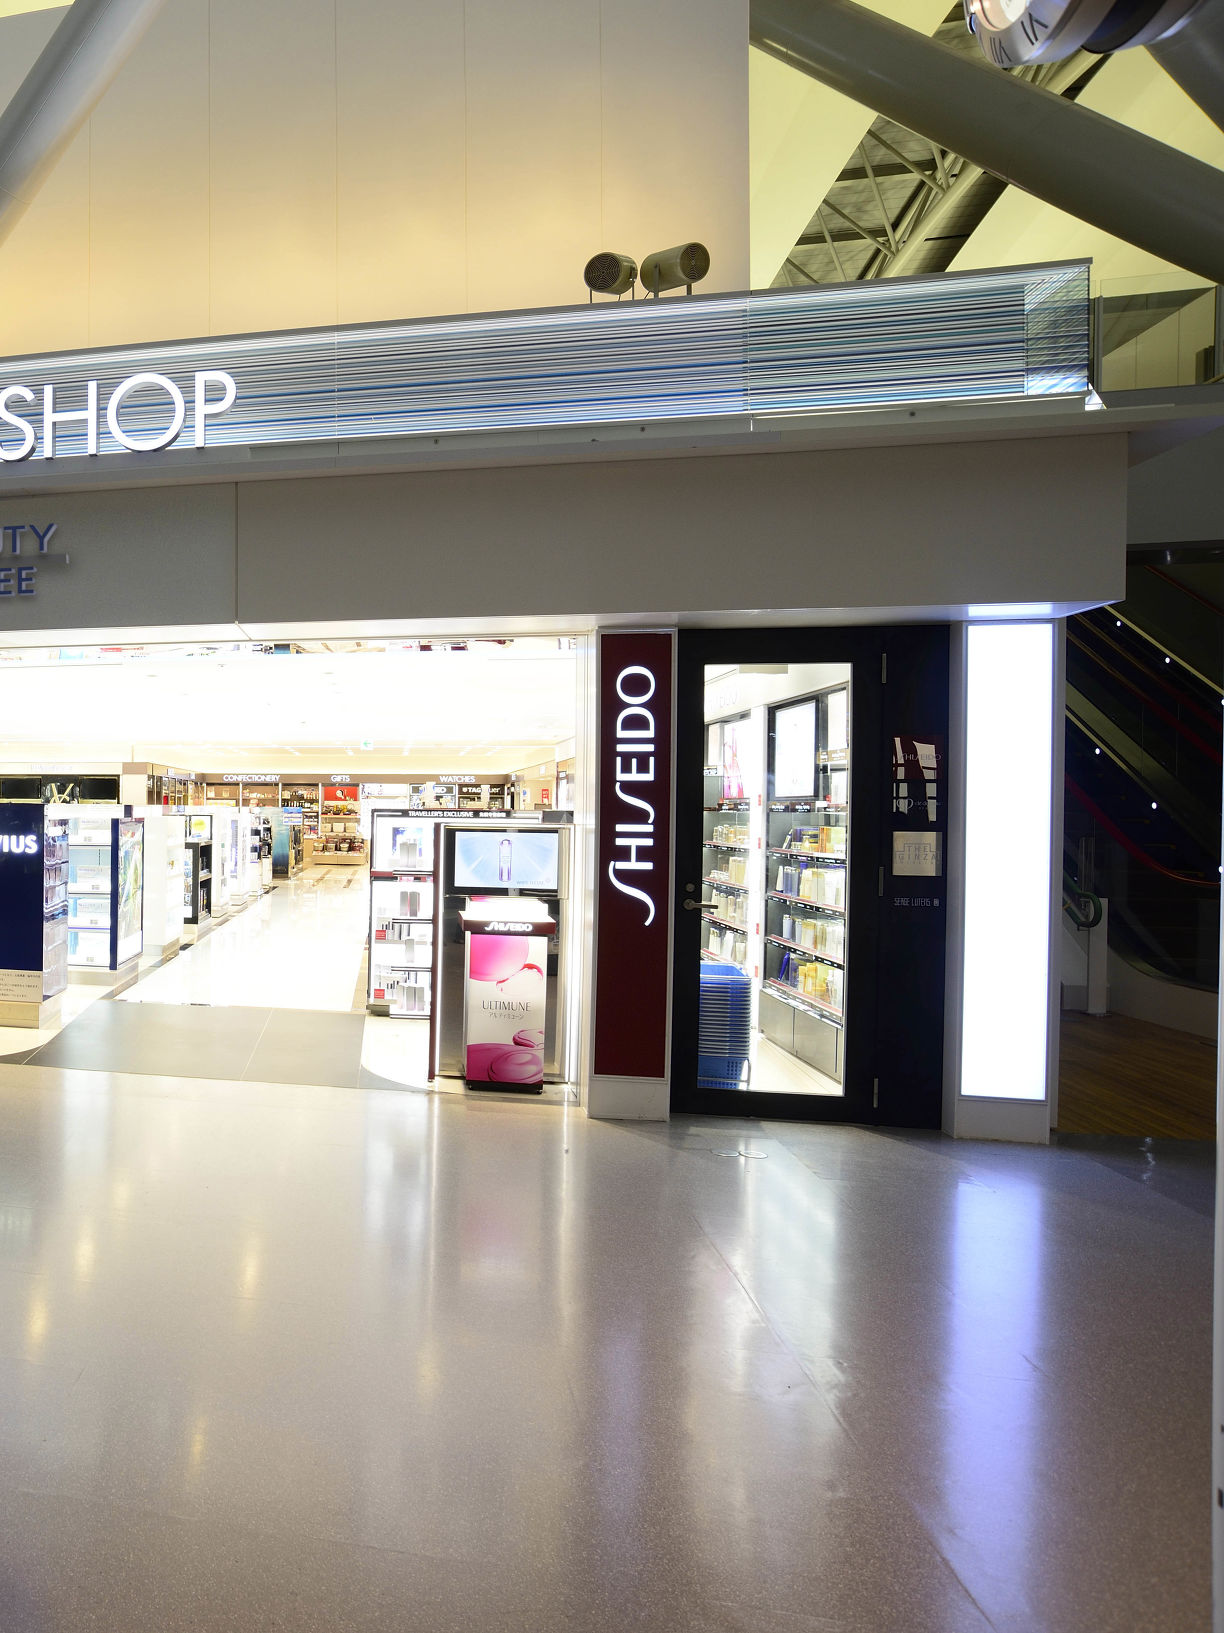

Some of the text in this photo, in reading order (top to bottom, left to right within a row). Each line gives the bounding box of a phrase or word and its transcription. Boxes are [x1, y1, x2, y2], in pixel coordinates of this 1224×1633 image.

[223, 774, 280, 782] CONFECTIONERY
[330, 774, 351, 782] GIFTS
[608, 665, 656, 926] SHISEIDO
[408, 810, 443, 818] TRAVELLER'S
[484, 922, 533, 931] SHISEIDO
[482, 999, 532, 1012] ULTIMUNE
